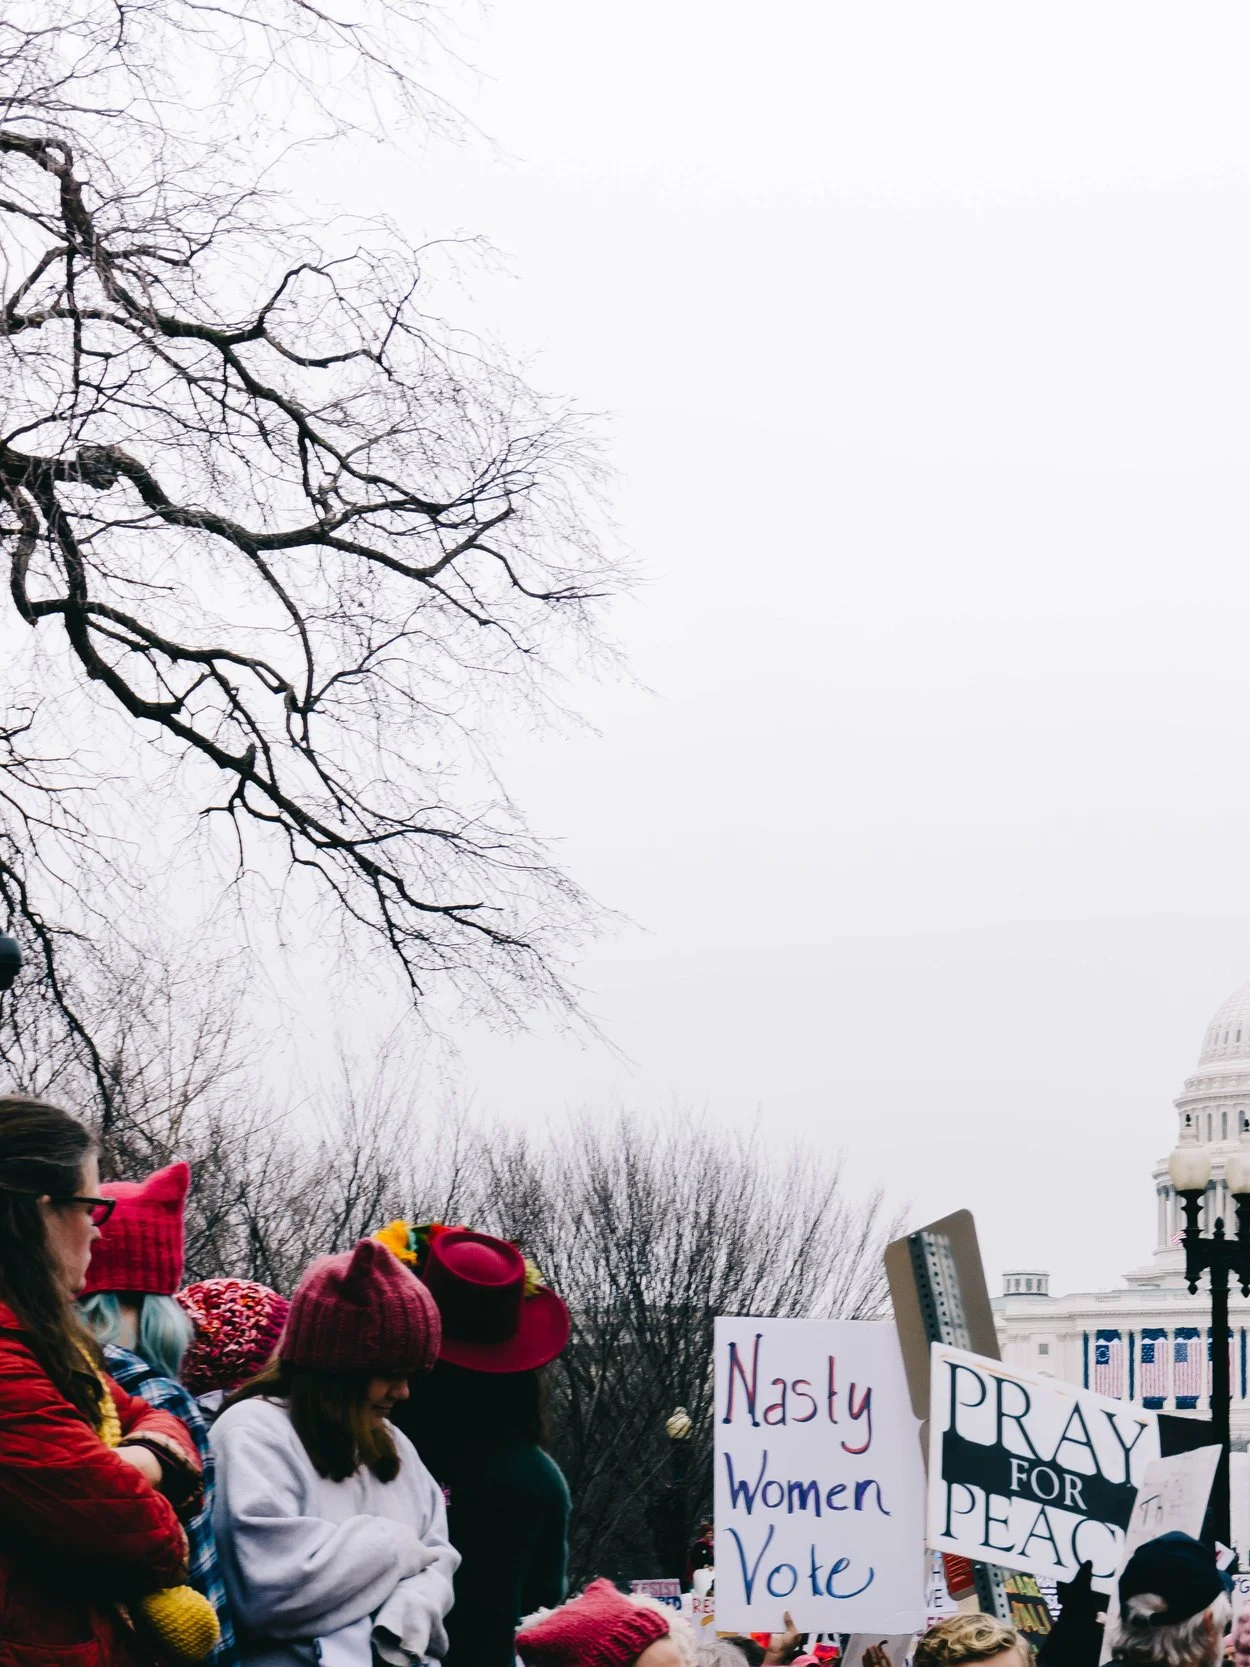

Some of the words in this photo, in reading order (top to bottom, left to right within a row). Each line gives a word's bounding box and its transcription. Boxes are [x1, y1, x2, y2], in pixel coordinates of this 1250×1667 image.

[722, 1333, 872, 1454] Nasty
[942, 1360, 1148, 1488] PRAY
[723, 1449, 893, 1517] Women
[1009, 1458, 1088, 1510] FOR
[722, 1523, 875, 1606] Vote
